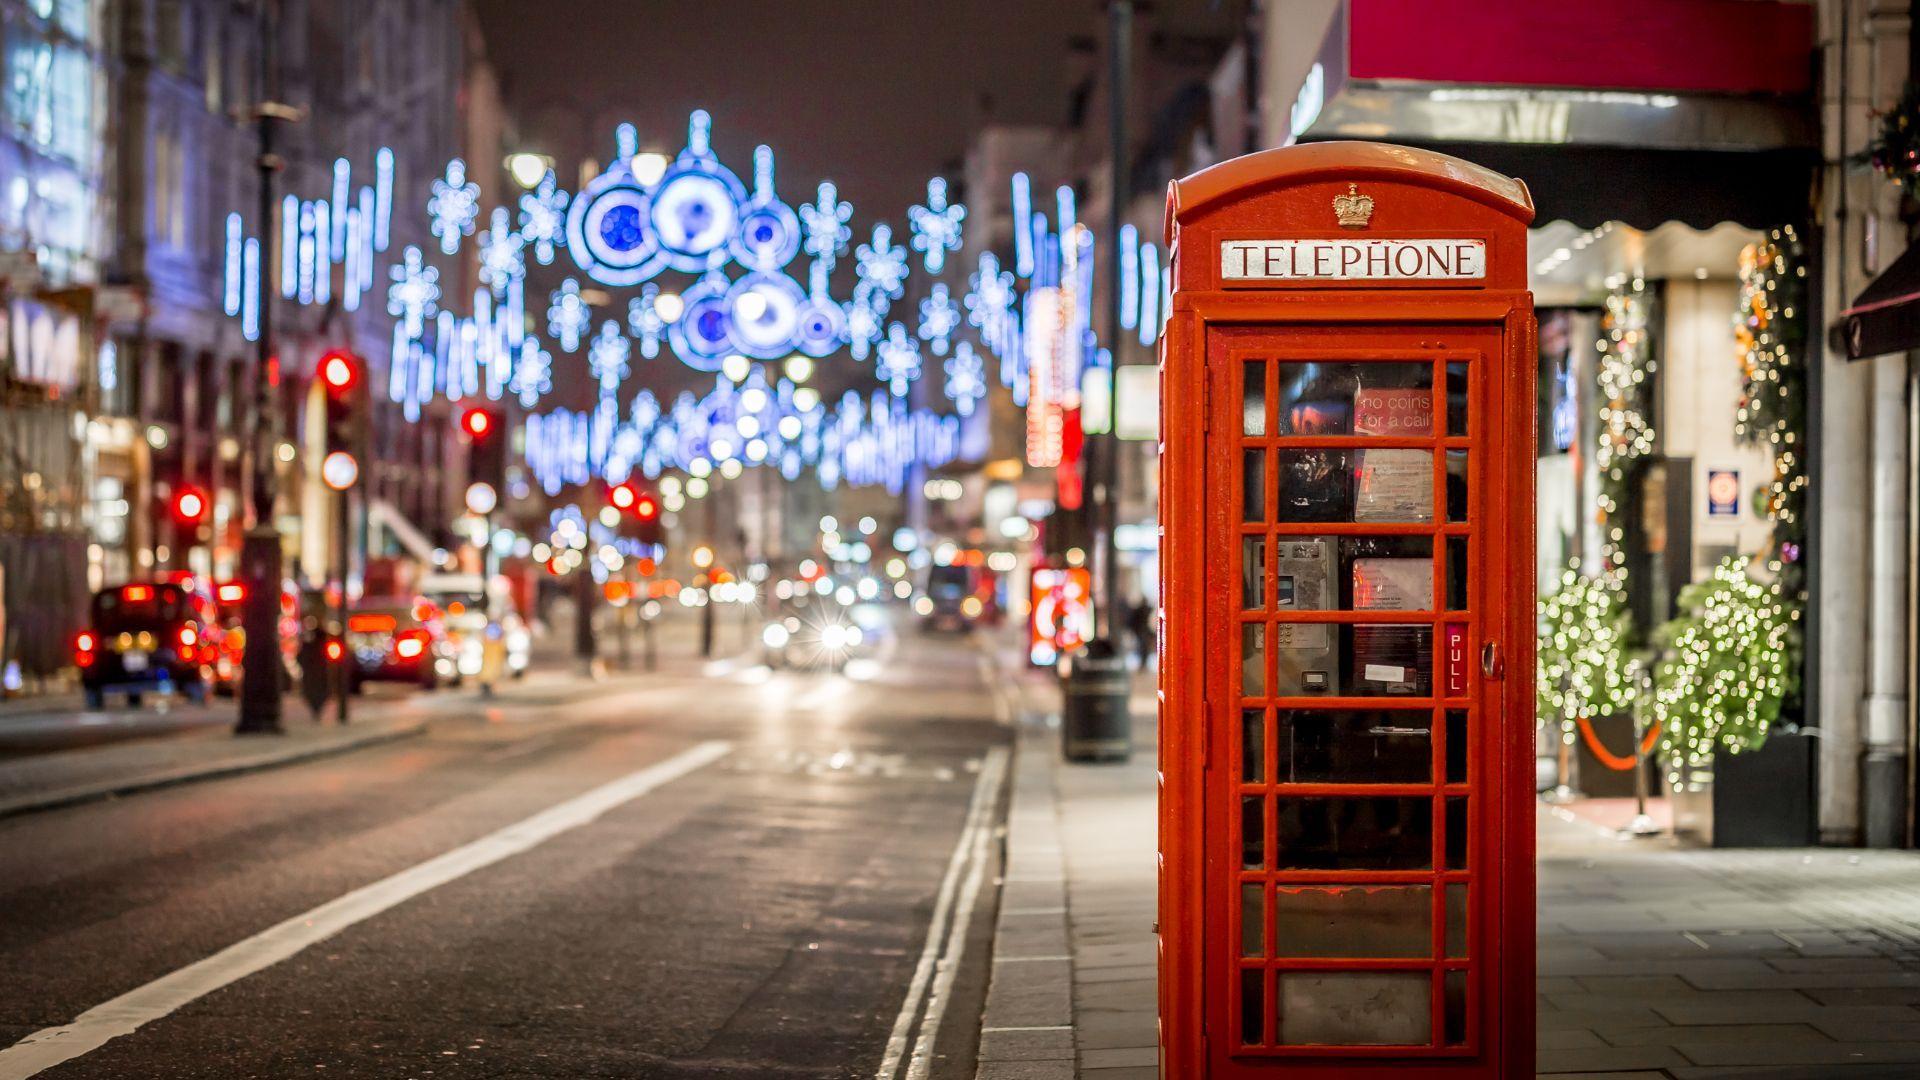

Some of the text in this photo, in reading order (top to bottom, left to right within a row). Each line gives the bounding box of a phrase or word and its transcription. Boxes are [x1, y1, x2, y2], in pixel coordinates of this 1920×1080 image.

[1233, 245, 1475, 277] TELEPHONE
[1362, 394, 1430, 409] no coins
[1389, 416, 1399, 427] a
[1451, 634, 1461, 690] PULL
